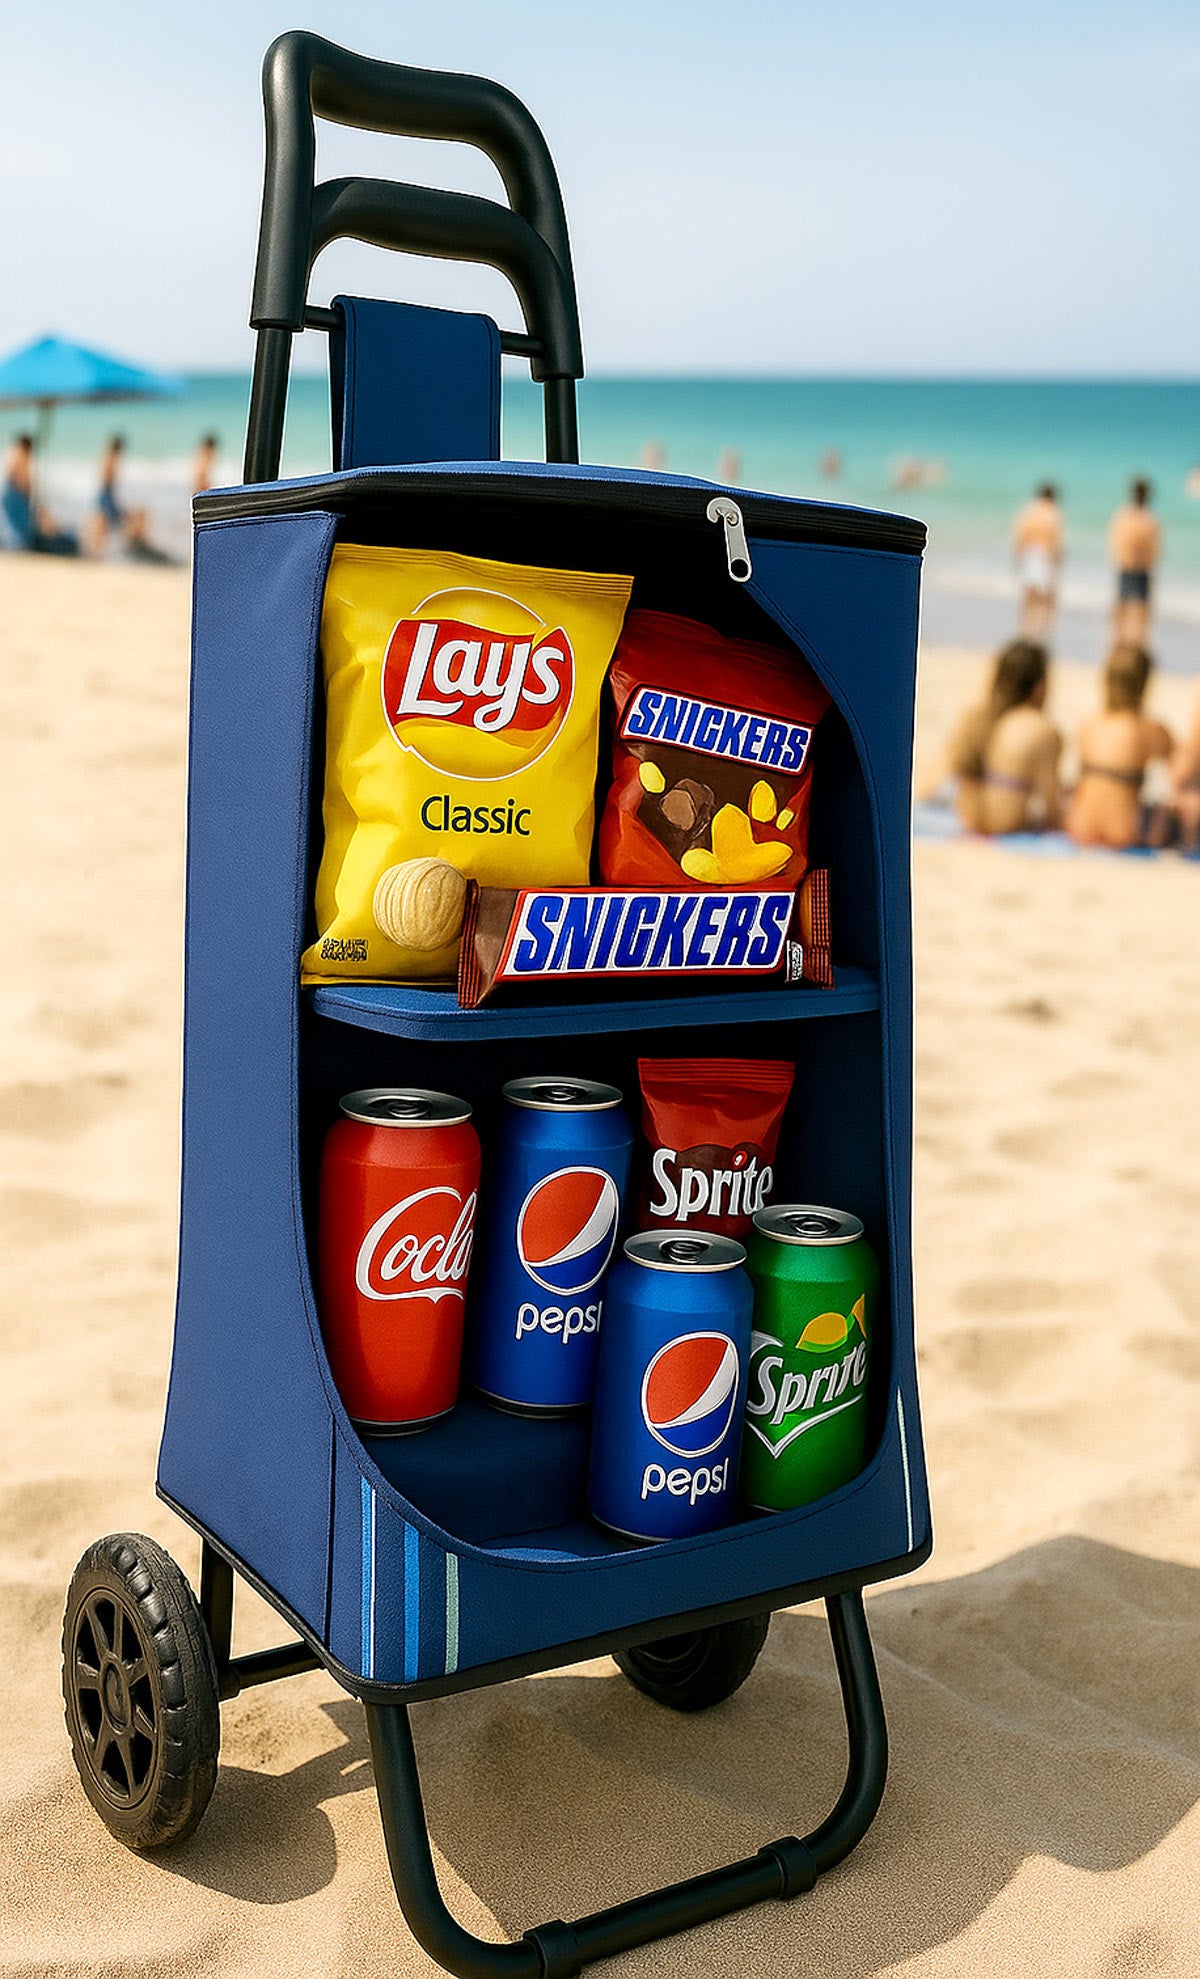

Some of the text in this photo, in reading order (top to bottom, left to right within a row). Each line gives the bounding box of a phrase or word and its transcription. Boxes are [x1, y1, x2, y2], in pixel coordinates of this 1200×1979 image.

[396, 622, 564, 732] Lays
[628, 691, 809, 770] SNICKERS
[421, 795, 531, 836] Classic
[514, 895, 791, 972] SNICKERS
[650, 1148, 773, 1222] Sprite
